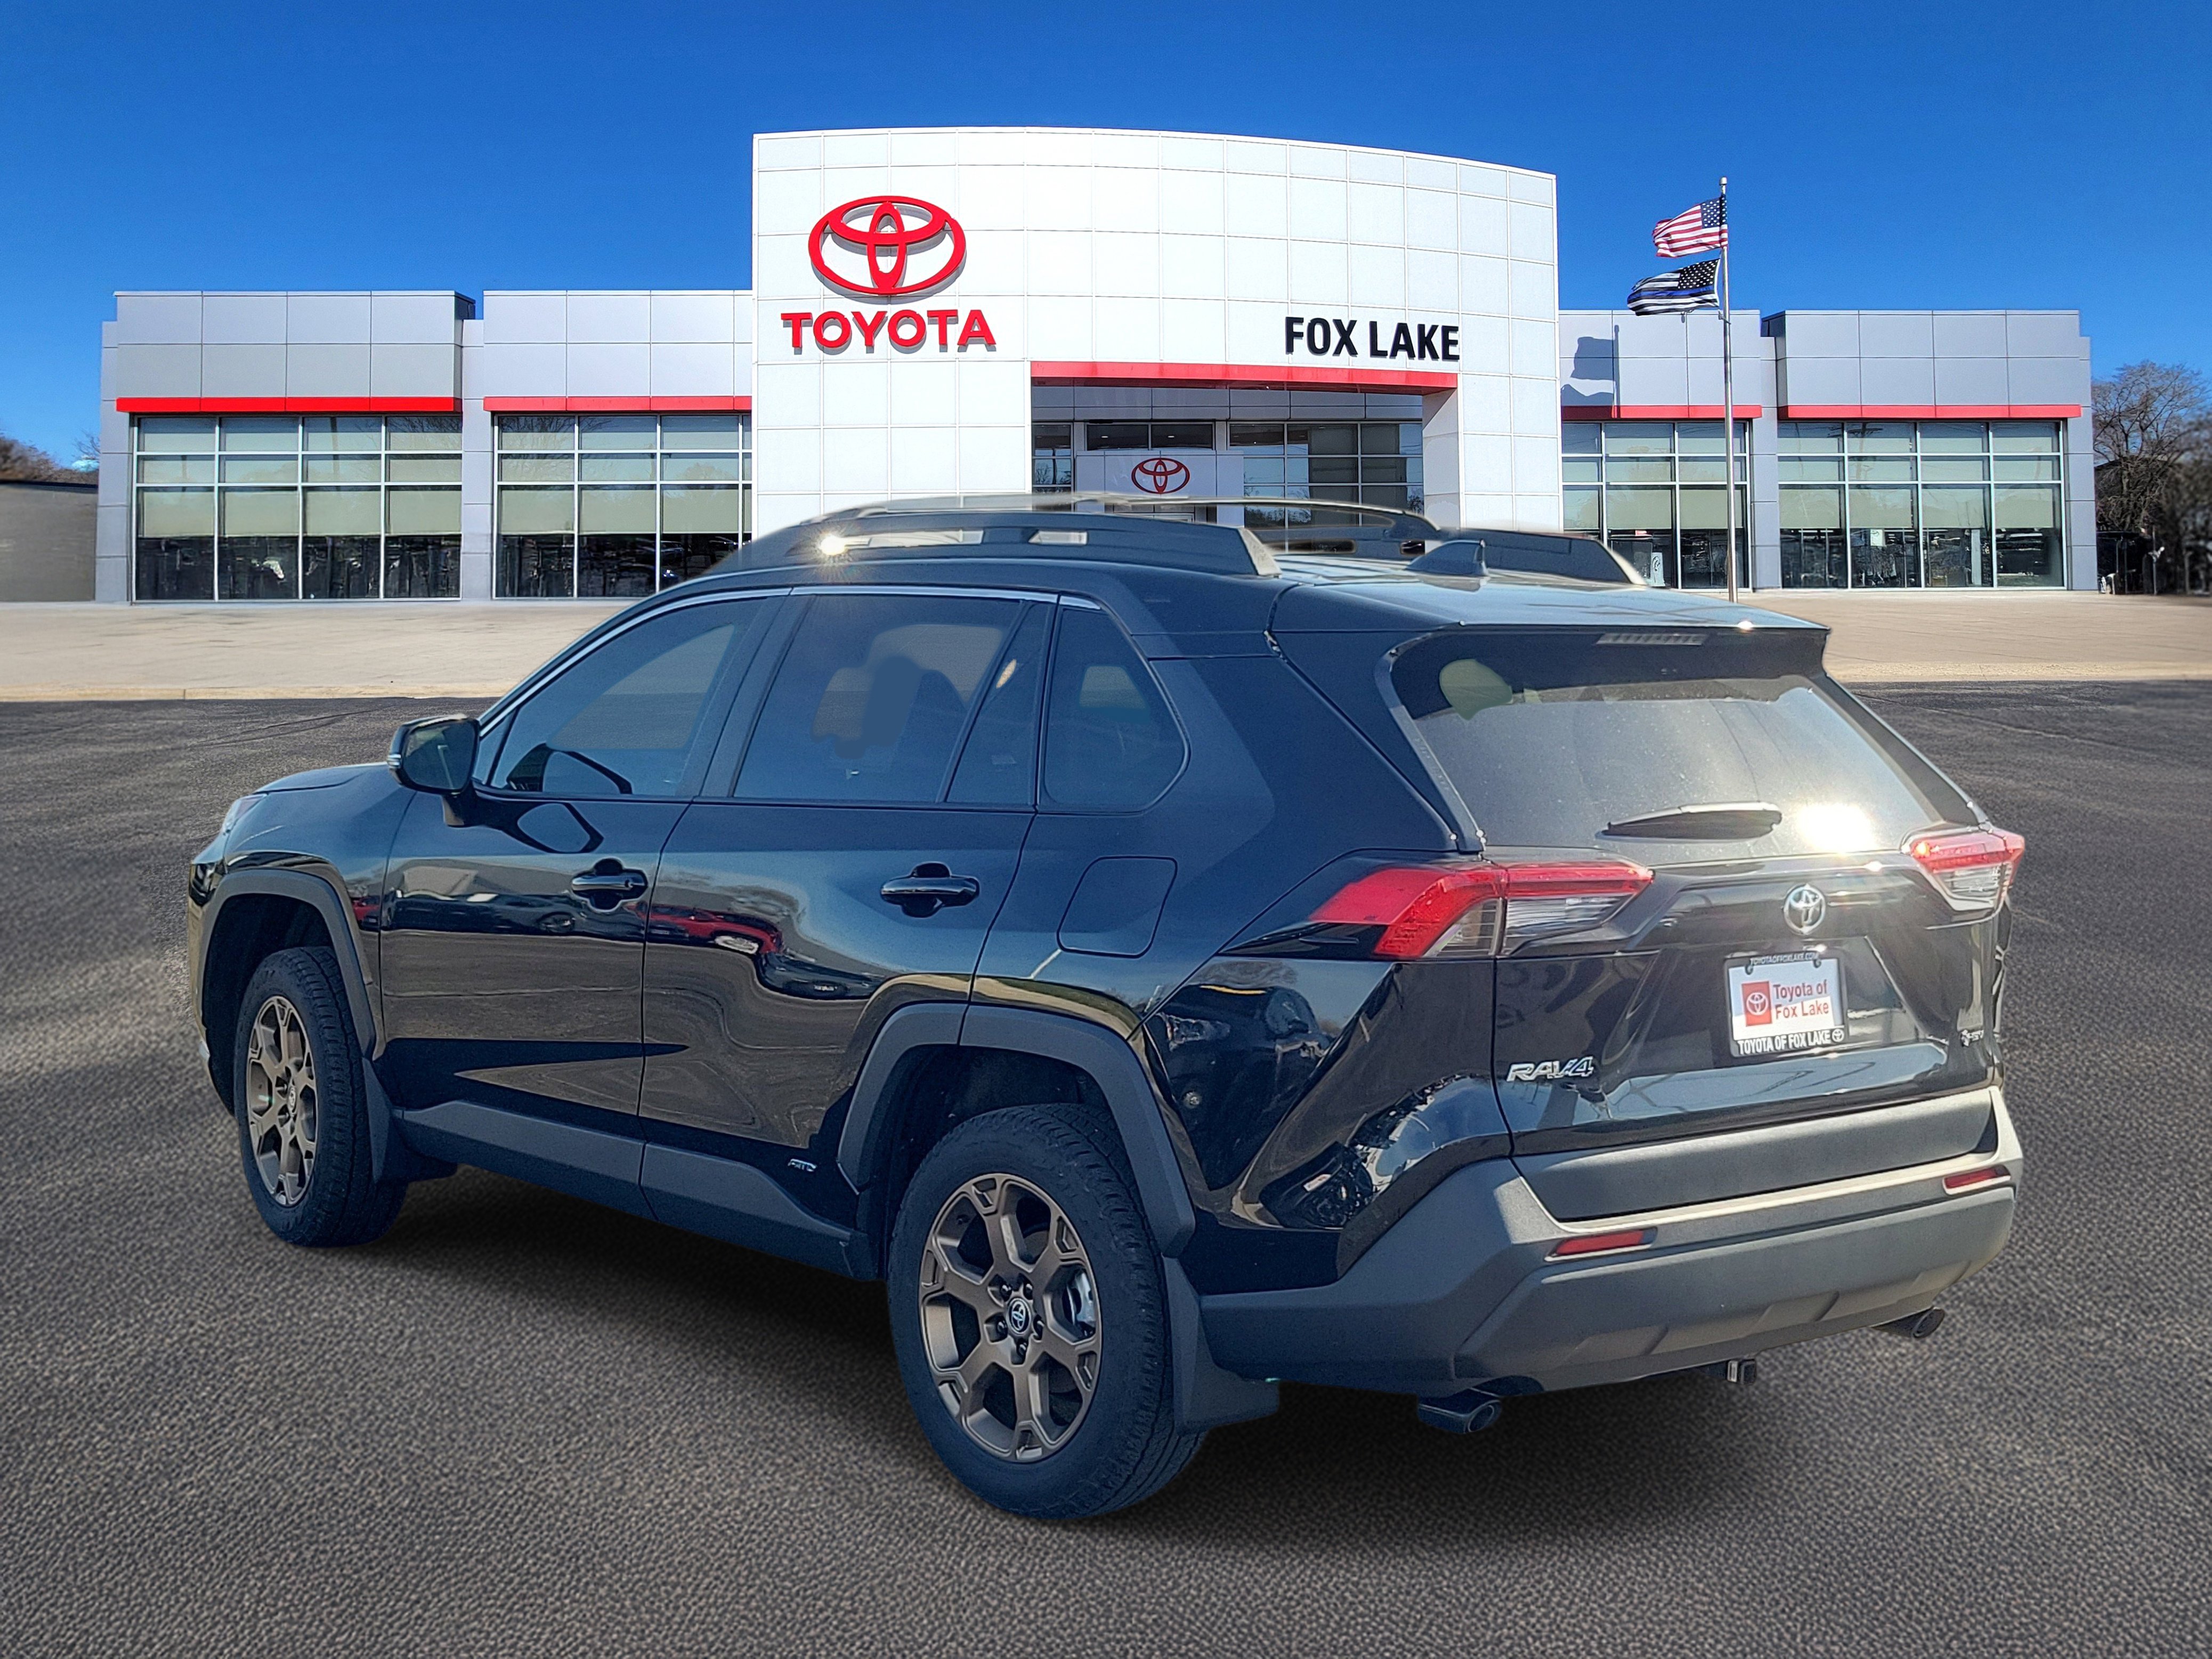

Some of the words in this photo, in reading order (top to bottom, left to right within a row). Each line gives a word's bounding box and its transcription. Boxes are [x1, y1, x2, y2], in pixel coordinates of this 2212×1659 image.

[781, 310, 996, 349] TOYOTA
[1285, 317, 1358, 357] FOX
[1368, 321, 1460, 361] LAKE
[1773, 983, 1813, 1002] Toyota
[1816, 979, 1827, 994] of
[1775, 1004, 1798, 1019] Fox
[1801, 1000, 1829, 1016] Lake
[1737, 1036, 1773, 1055] TOYOTA
[1775, 1035, 1787, 1050] OF
[1788, 1032, 1806, 1049] FOX
[1807, 1030, 1831, 1047] LAKE
[1506, 1056, 1594, 1081] RAV4
